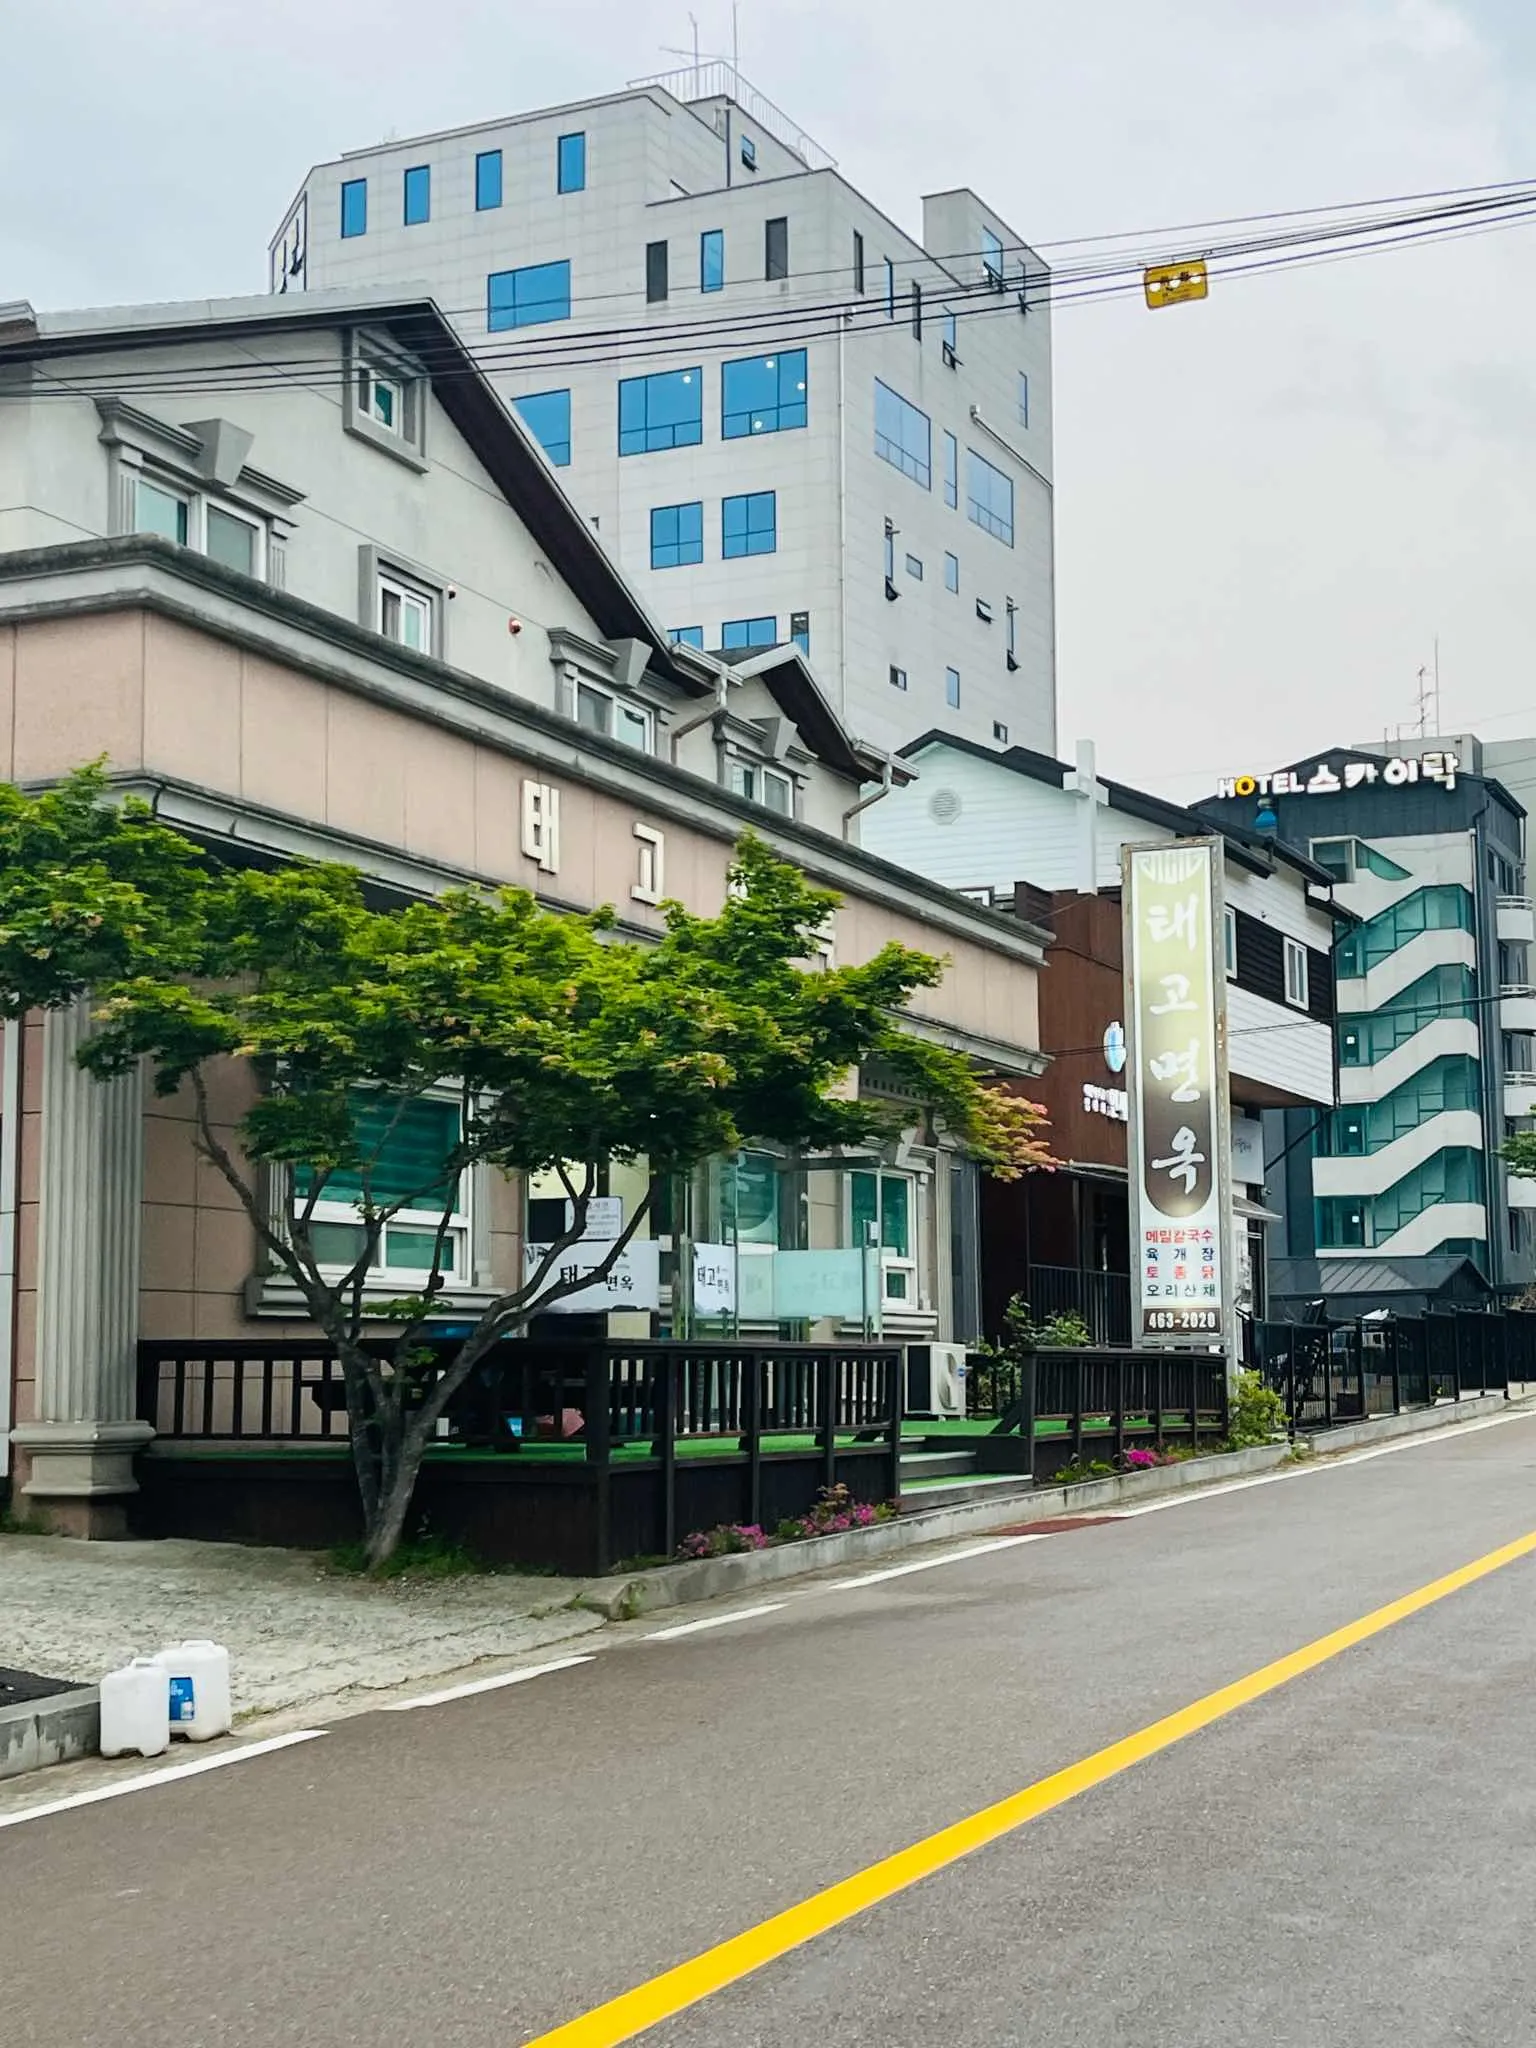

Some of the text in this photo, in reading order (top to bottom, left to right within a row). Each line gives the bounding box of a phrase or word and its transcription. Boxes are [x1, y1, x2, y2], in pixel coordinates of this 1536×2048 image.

[1217, 751, 1460, 799] HOTEL 스카이락
[1145, 1228, 1214, 1244] 메밀칼국수
[1148, 1311, 1217, 1330] 463-2020
